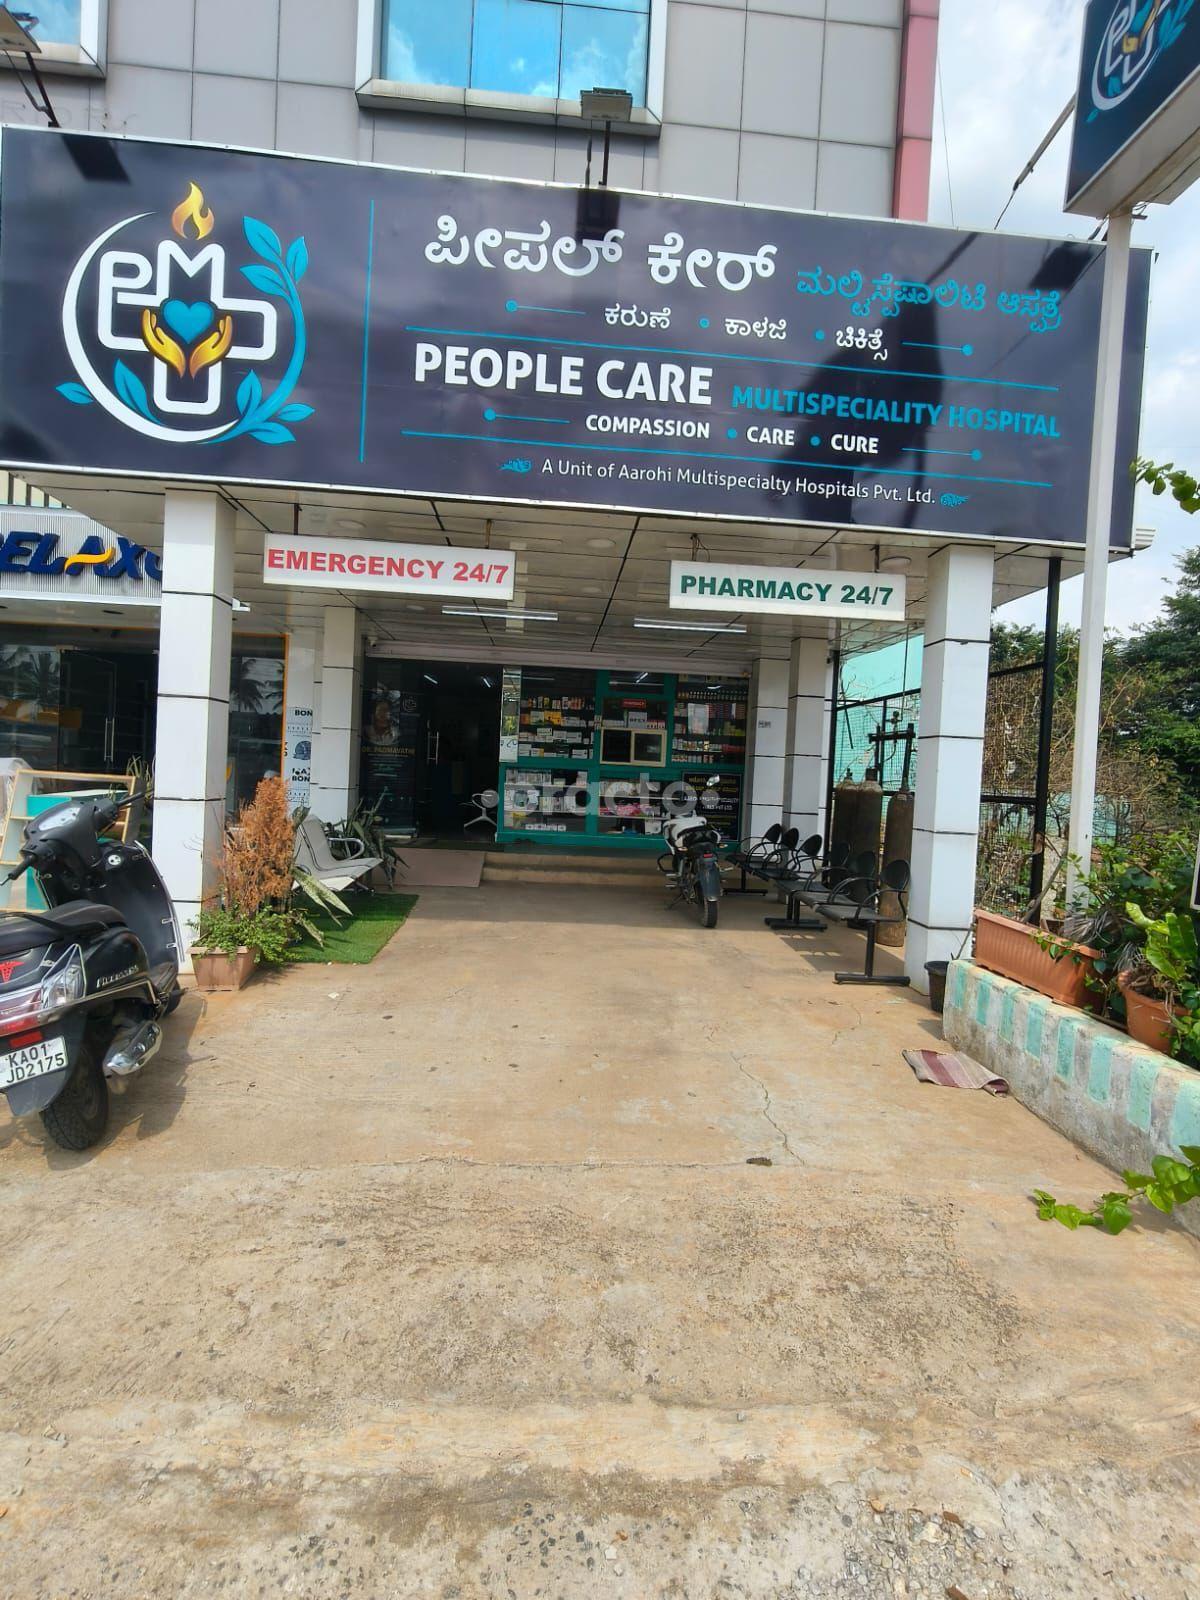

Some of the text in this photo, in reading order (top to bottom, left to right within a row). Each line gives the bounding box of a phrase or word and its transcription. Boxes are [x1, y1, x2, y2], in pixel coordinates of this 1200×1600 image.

[424, 214, 626, 277] ಪೀಪಲ್
[647, 232, 778, 291] ಕೇರ್
[604, 302, 889, 361] ಕರುಣೆ ಕಾಳಜಿ ಚಿಕಿತ್ಸೆ
[415, 342, 1061, 439] PEOPLE CARE MULTISPECIALITY HOSPITAL
[585, 414, 880, 455] COMPASSION CARE CURE
[541, 458, 936, 504] A Unit of Aarohi Multispecialty Hospitals Pvt. Ltd.
[267, 549, 509, 584] EMERGENCY 24/7
[680, 575, 894, 606] PHARMACY 24/7
[6, 1052, 66, 1084] JD2175
[8, 1042, 48, 1068] KA01
